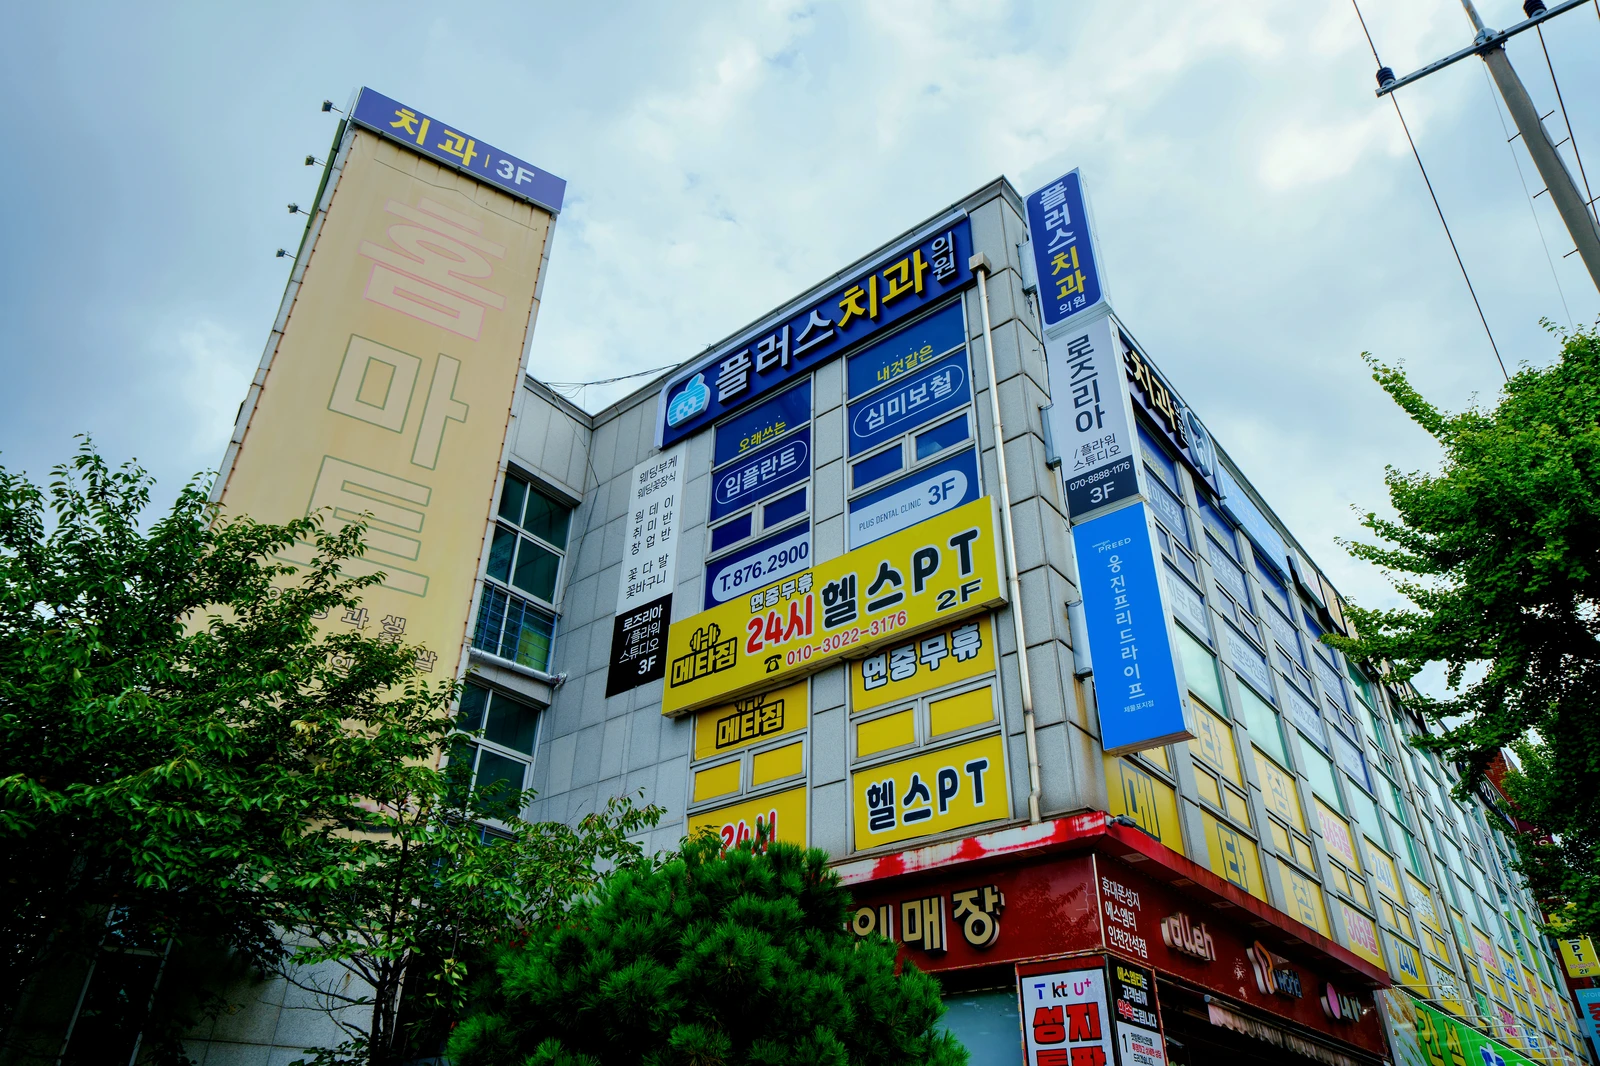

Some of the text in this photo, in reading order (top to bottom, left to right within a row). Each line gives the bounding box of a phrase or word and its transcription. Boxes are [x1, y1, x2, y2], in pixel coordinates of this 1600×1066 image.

[389, 108, 535, 185] 치과 3F
[1059, 294, 1087, 314] 의원
[877, 344, 934, 381] 내것같은
[1066, 334, 1105, 433] 로즈리아
[865, 371, 952, 430] 심미보철
[738, 421, 787, 453] 오래쓰는
[639, 455, 678, 485] 웨딩부케
[725, 447, 797, 498] 임플란트
[1073, 444, 1122, 472] 스튜디오
[637, 471, 677, 499] 웨딩꽃장식
[1070, 461, 1131, 491] 070-8888-1176
[859, 477, 956, 531] PLUS DENTAL CLINIC 3F
[1090, 481, 1115, 504] 3F
[1098, 537, 1132, 553] PREED
[626, 570, 668, 600] 꽃바구니
[750, 572, 814, 614] 연중무휴
[935, 578, 982, 611] 2F
[623, 604, 663, 632] 로즈리아
[746, 594, 814, 655] 24시
[1107, 554, 1146, 700] 웅진프리드라이프
[619, 636, 660, 664] 스튜디오
[786, 611, 907, 666] 010-3022-3176
[638, 658, 656, 676] 3F
[671, 637, 738, 688] 메타짐
[861, 622, 983, 691] 연중무휴
[1123, 699, 1154, 713] 제물포지점
[716, 699, 784, 749] 메타짐
[1102, 876, 1141, 911] 휴대폰성지
[1105, 901, 1137, 931] 에스엠티
[1344, 906, 1379, 957] 365일
[1108, 925, 1148, 959] 인천간석점
[1052, 981, 1068, 998] kt
[1073, 978, 1092, 996] U+
[1116, 966, 1148, 990] 에스엠티는
[1122, 984, 1148, 1006] 고객님께
[1033, 1002, 1102, 1045] 성지
[1117, 999, 1158, 1028] 약속드립니다
[1122, 1034, 1128, 1053] 1
